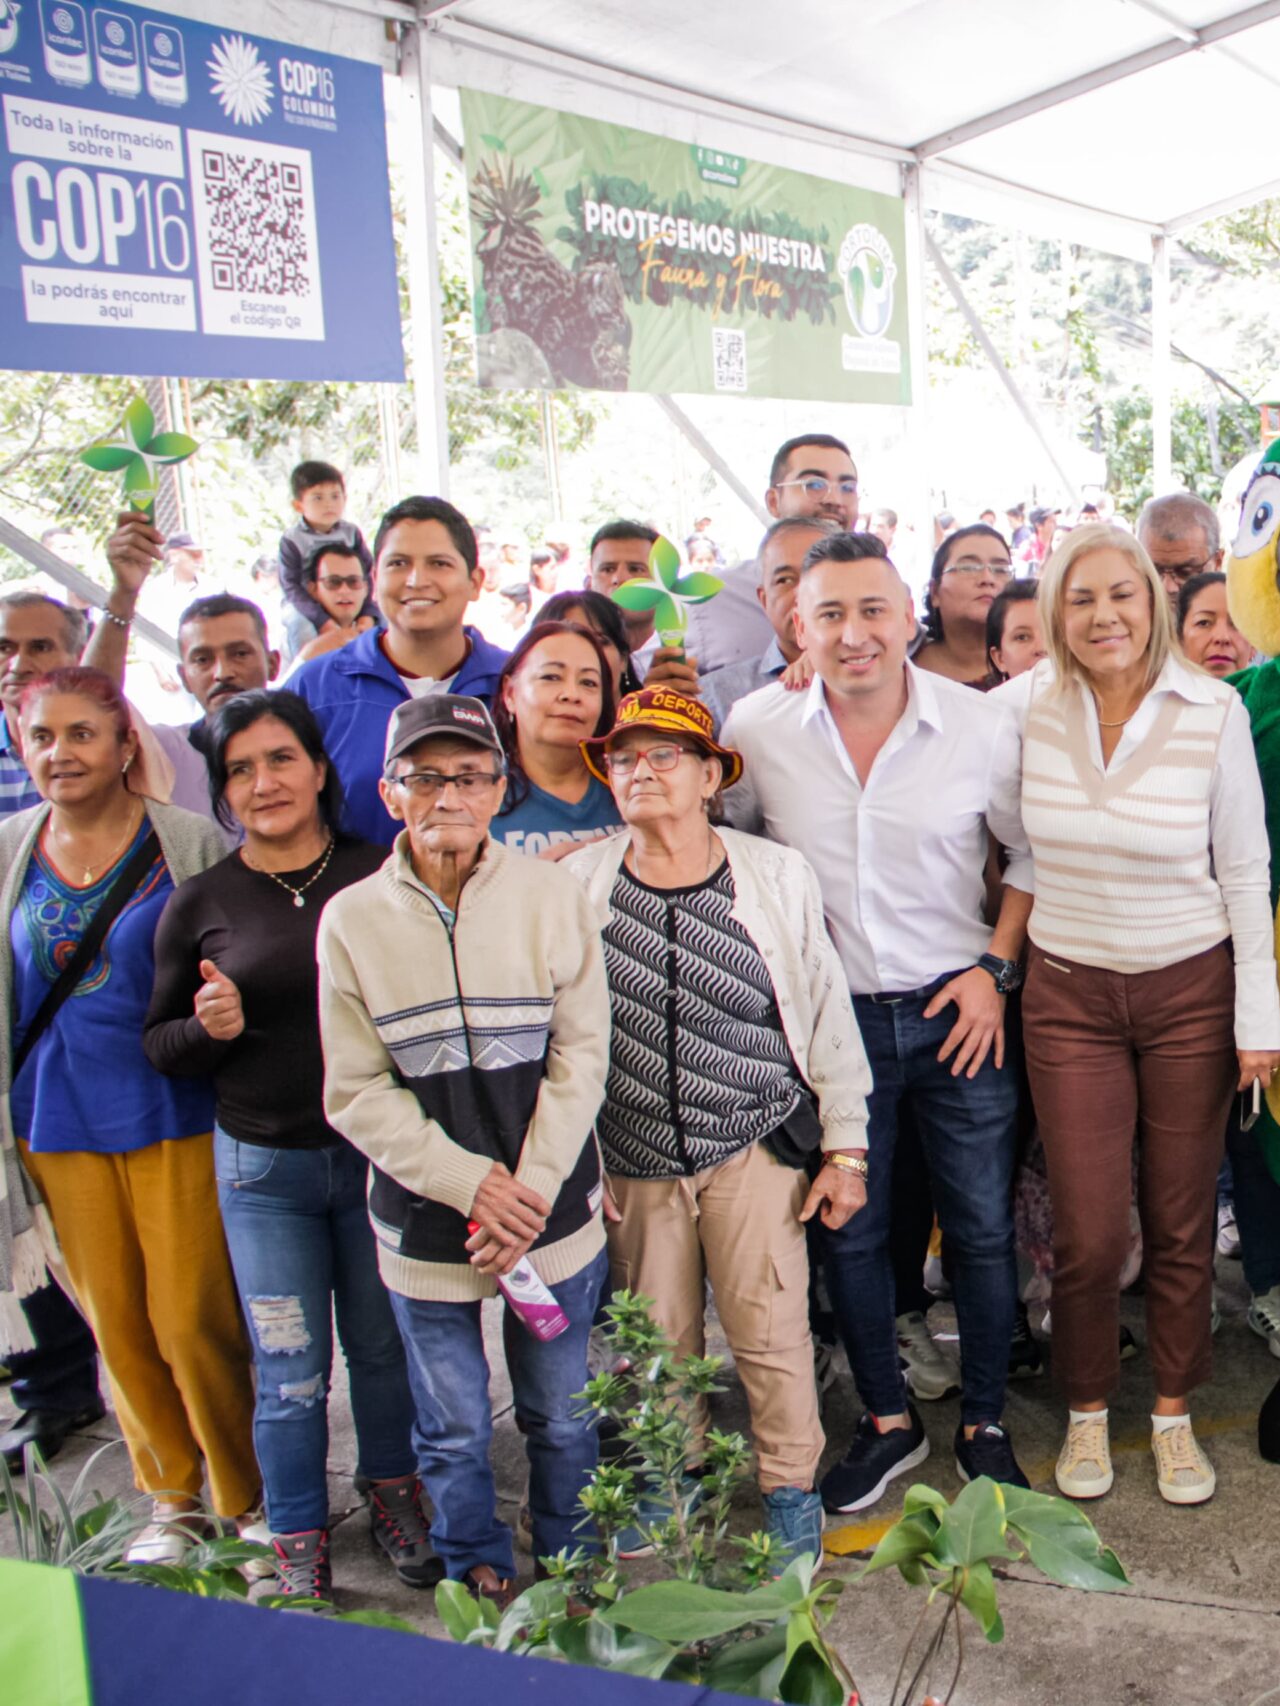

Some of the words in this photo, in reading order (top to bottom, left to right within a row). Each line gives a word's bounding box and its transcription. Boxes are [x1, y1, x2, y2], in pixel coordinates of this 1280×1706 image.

[279, 57, 335, 102] COP16
[282, 94, 337, 120] COLOMBIA
[10, 109, 54, 132] Toda
[59, 117, 74, 135] la
[78, 120, 174, 151] información
[68, 139, 114, 158] sobre
[118, 144, 133, 161] la
[11, 160, 191, 272] COP16
[584, 200, 736, 258] PROTEGEMOS
[739, 230, 826, 273] NUESTRA
[638, 231, 709, 301] Fauna
[31, 279, 47, 296] la
[51, 283, 109, 300] podrás
[112, 288, 187, 306] encontrar
[241, 299, 287, 315] Escanea
[230, 312, 241, 325] el
[243, 313, 283, 330] código
[284, 315, 302, 330] QR
